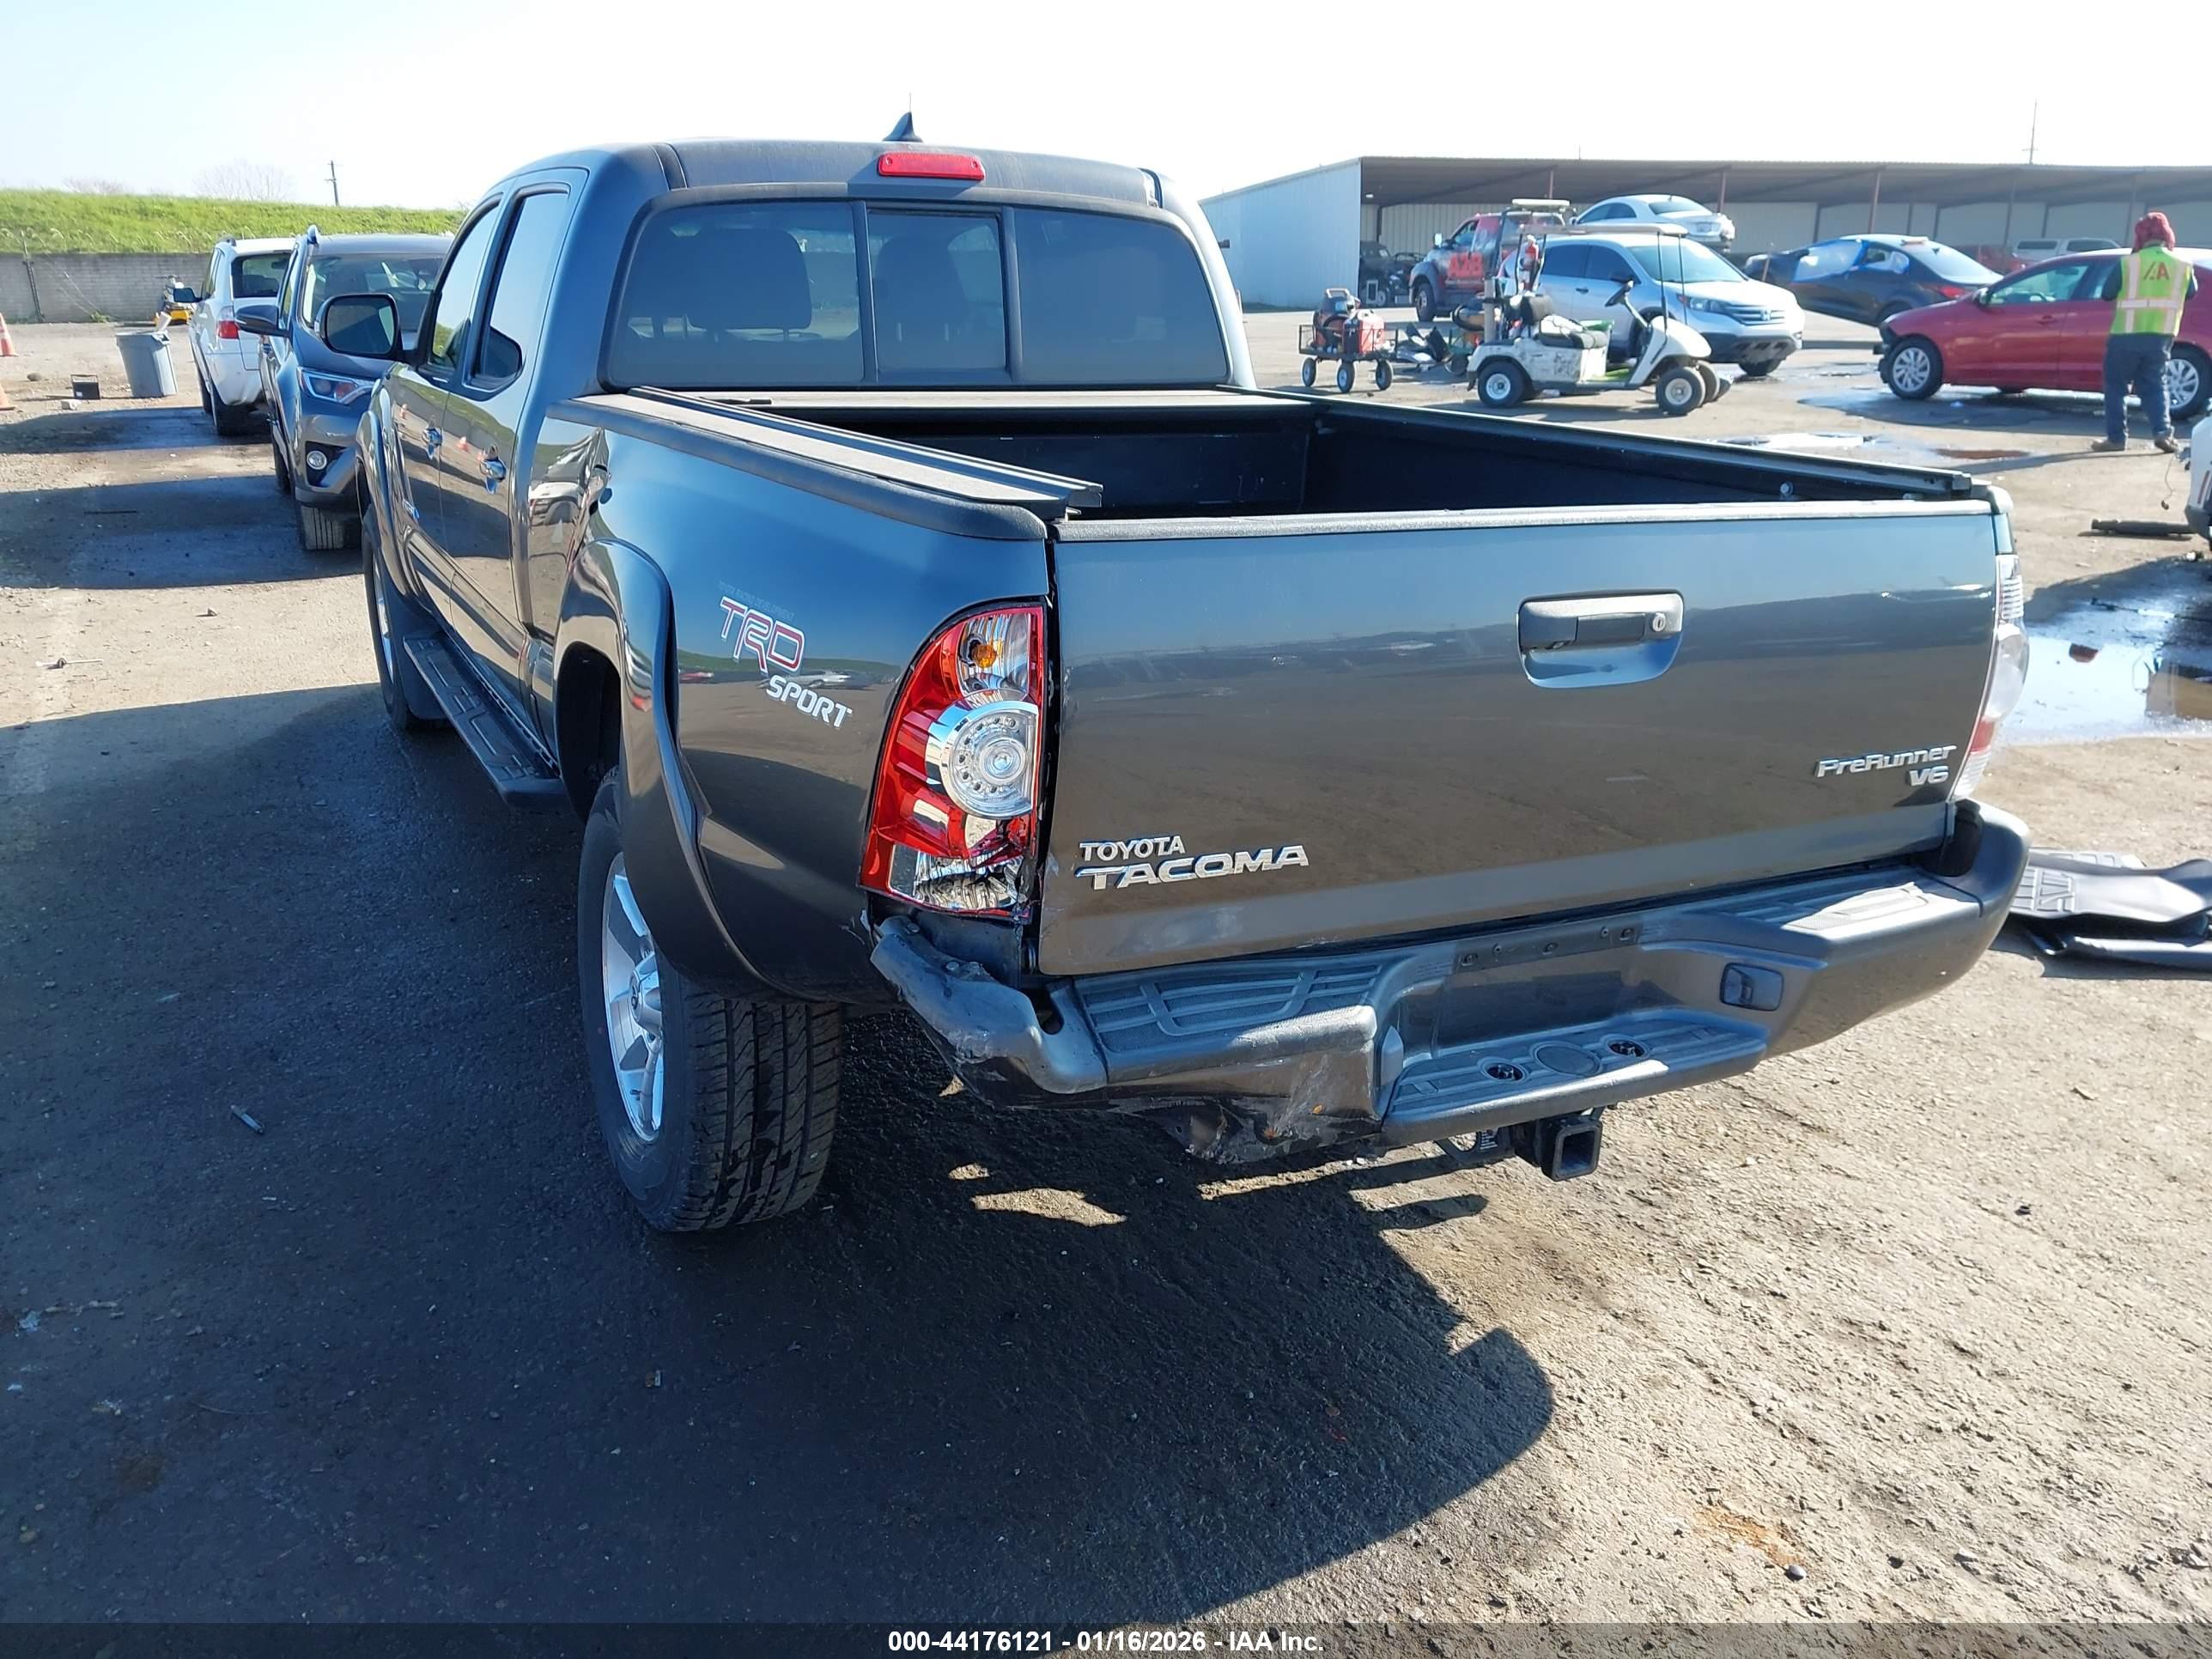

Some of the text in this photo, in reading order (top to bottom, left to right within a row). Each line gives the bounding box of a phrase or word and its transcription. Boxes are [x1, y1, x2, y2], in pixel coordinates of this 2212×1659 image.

[720, 596, 805, 673] TRD
[766, 675, 853, 728] SPORT
[1815, 744, 1957, 778] PreRunner
[1908, 765, 1949, 787] V6
[1075, 845, 1310, 890] TACOMA
[1079, 836, 1185, 862] TOYOTA
